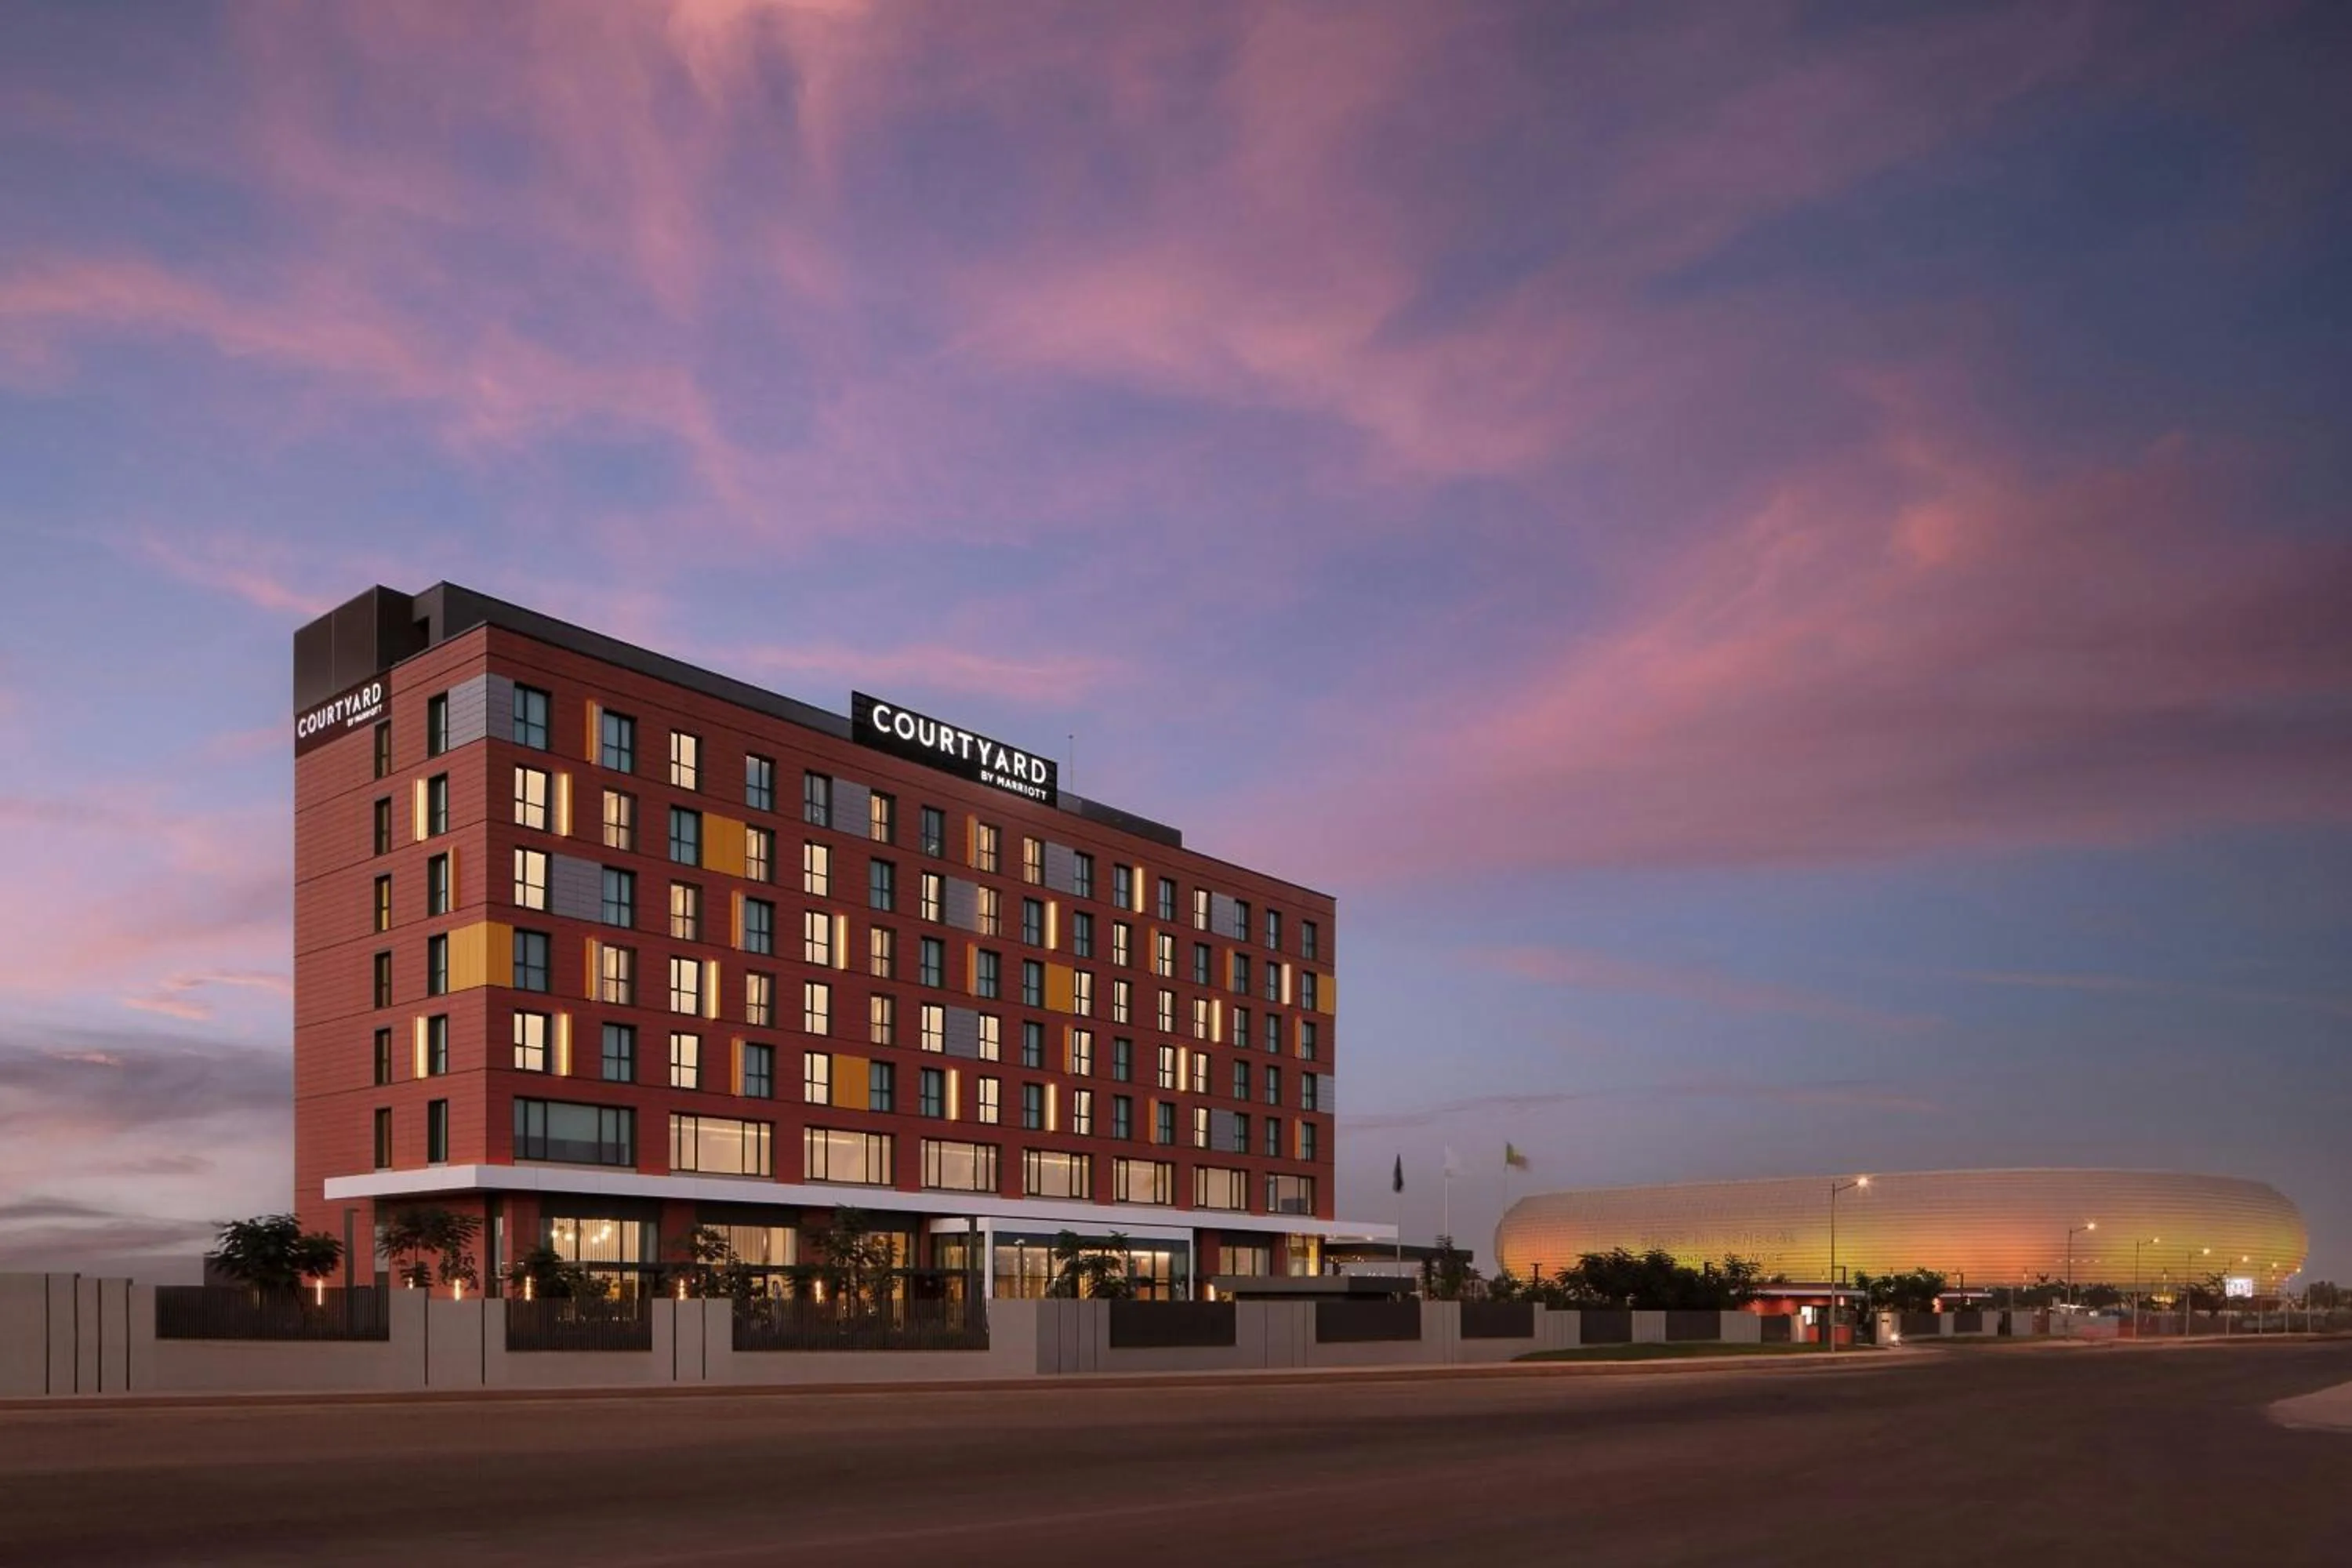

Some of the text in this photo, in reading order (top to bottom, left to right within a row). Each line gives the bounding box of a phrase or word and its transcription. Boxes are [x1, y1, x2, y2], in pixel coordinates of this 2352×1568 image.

[298, 683, 381, 738] COURTYARD
[873, 705, 1047, 783] COURTYARD
[981, 770, 1047, 800] BY MARRIOTT
